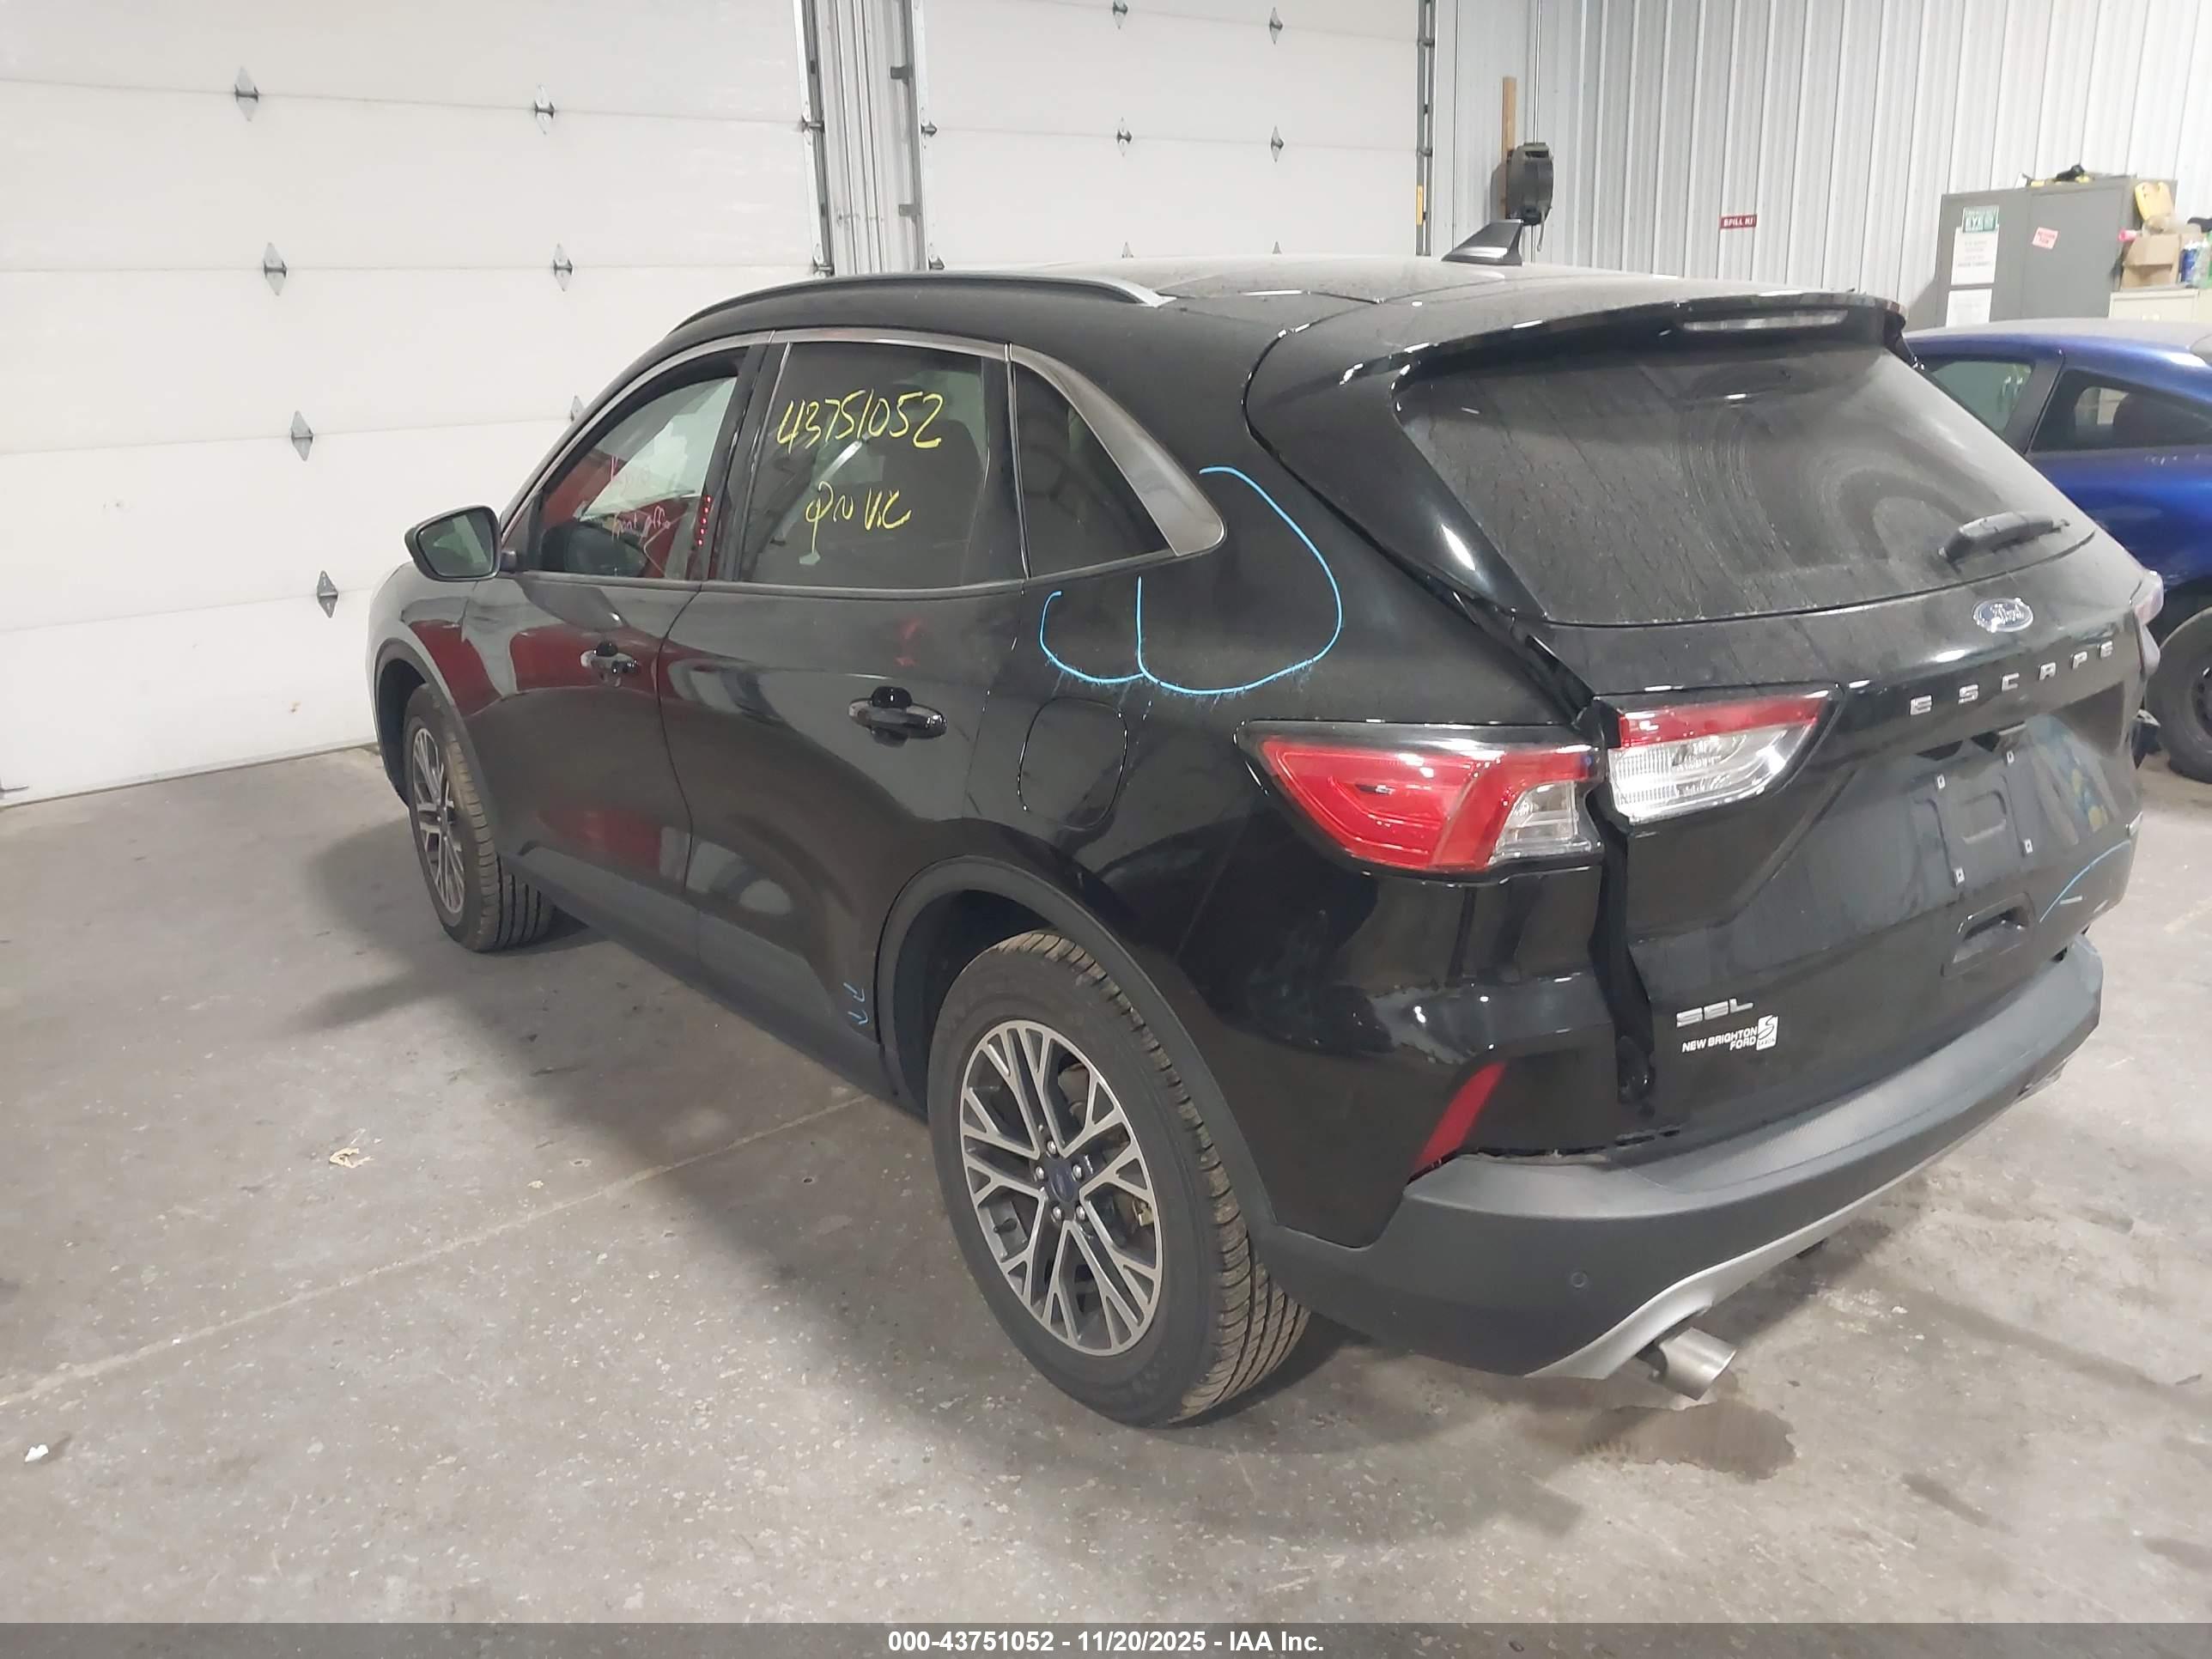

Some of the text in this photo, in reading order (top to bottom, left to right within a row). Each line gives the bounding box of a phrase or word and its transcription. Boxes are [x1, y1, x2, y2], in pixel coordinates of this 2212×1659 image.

[776, 388, 944, 454] 43751052
[1910, 640, 2114, 715] ESCAPE
[1676, 998, 1754, 1028] SEL
[1681, 1038, 1707, 1053] NEW
[1707, 1025, 1758, 1047] BRIGHTON
[1729, 1036, 1758, 1051] FORD
